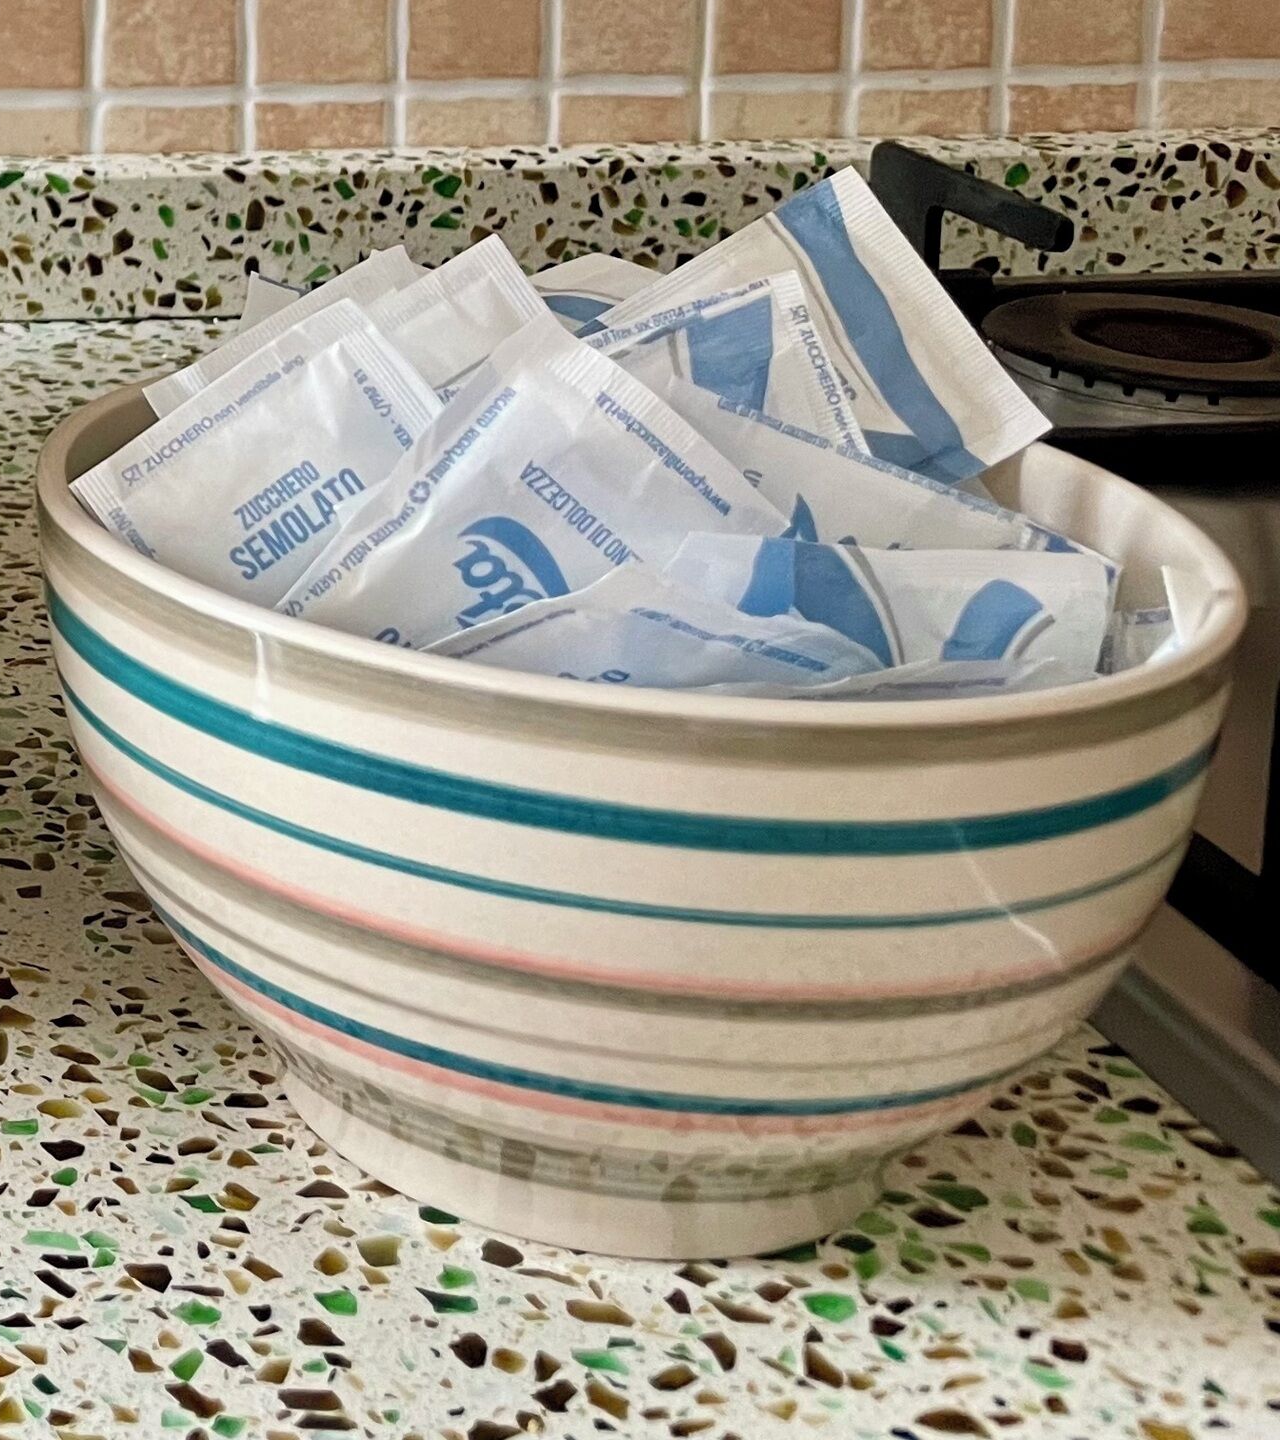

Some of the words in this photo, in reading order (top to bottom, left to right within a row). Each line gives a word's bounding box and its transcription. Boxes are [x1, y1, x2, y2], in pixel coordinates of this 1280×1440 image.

[799, 329, 841, 407] ZUCCHERO
[476, 387, 518, 430] INCARTO
[143, 418, 215, 474] ZUCCHERO
[428, 427, 481, 485] RICICLABILE
[233, 460, 321, 531] ZUCCHERO
[519, 459, 594, 535] DOLCEZZA
[229, 467, 366, 581] SEMOLATO
[369, 502, 416, 550] SMALTIRE
[585, 522, 612, 549] DI
[310, 565, 343, 599] CARTA
[339, 538, 373, 573] NELLA
